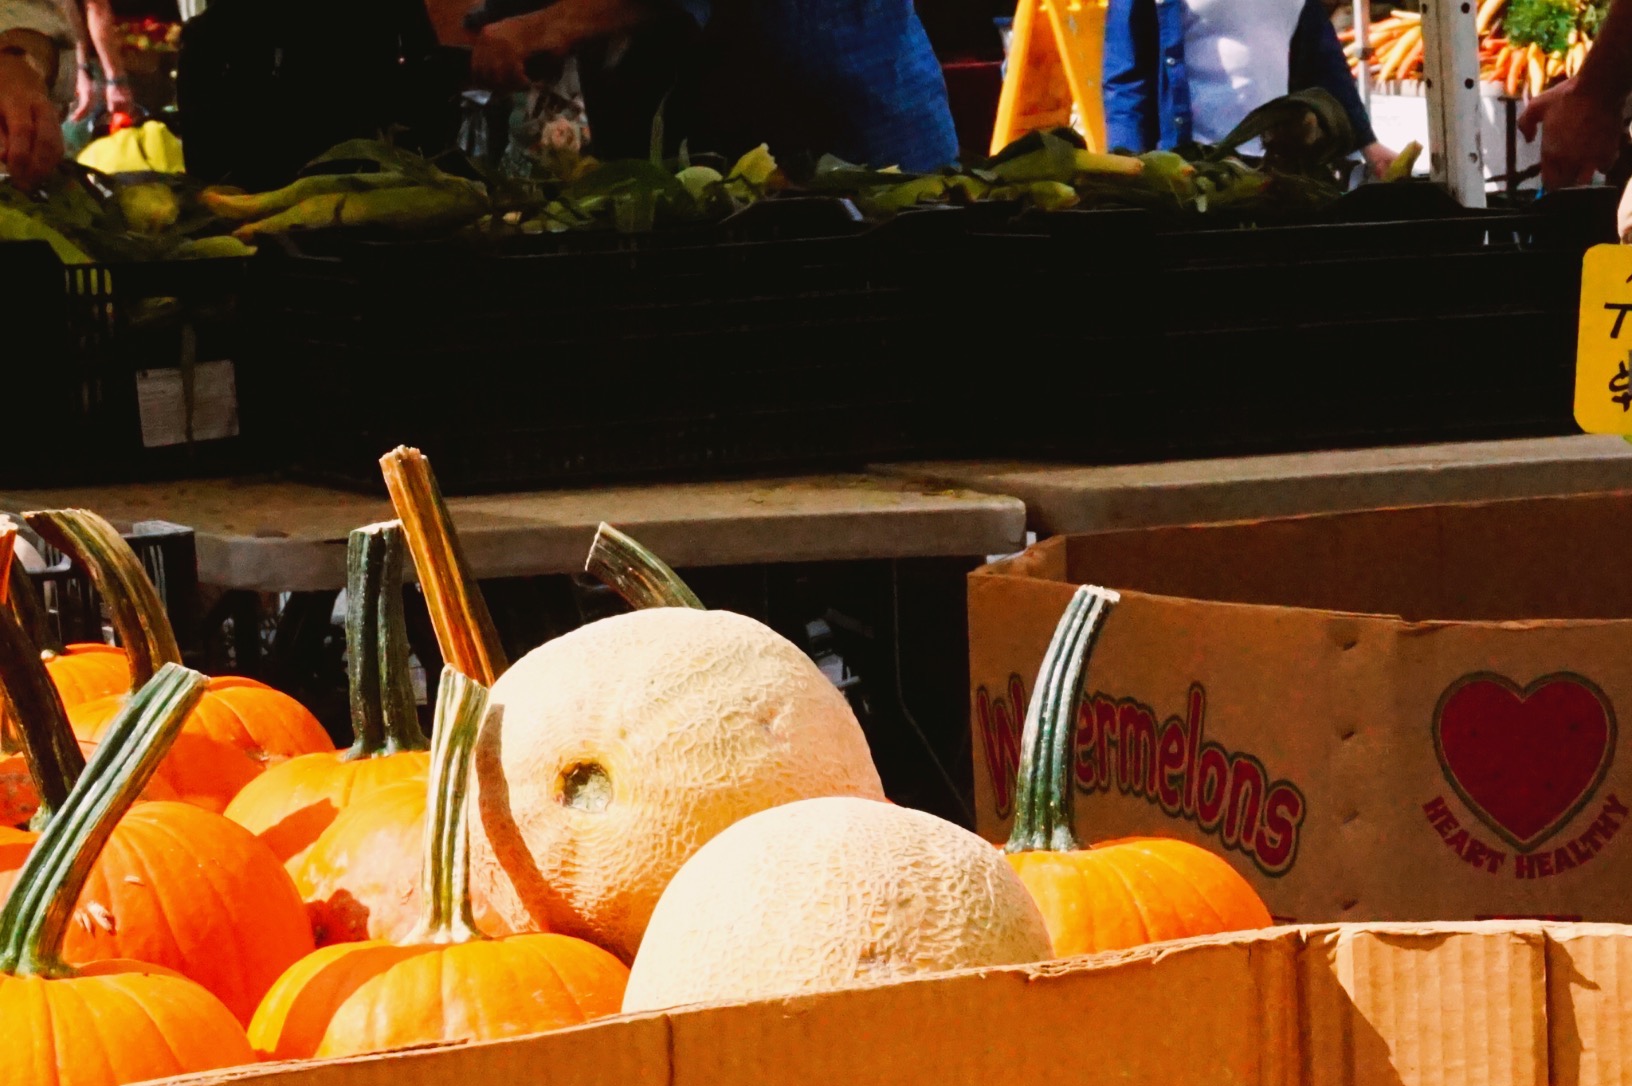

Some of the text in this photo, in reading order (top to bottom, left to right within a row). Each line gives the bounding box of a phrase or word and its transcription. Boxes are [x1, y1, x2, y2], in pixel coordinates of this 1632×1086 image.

[976, 672, 1306, 879] Wermelons
[1421, 793, 1630, 880] HEART HEALTHY
